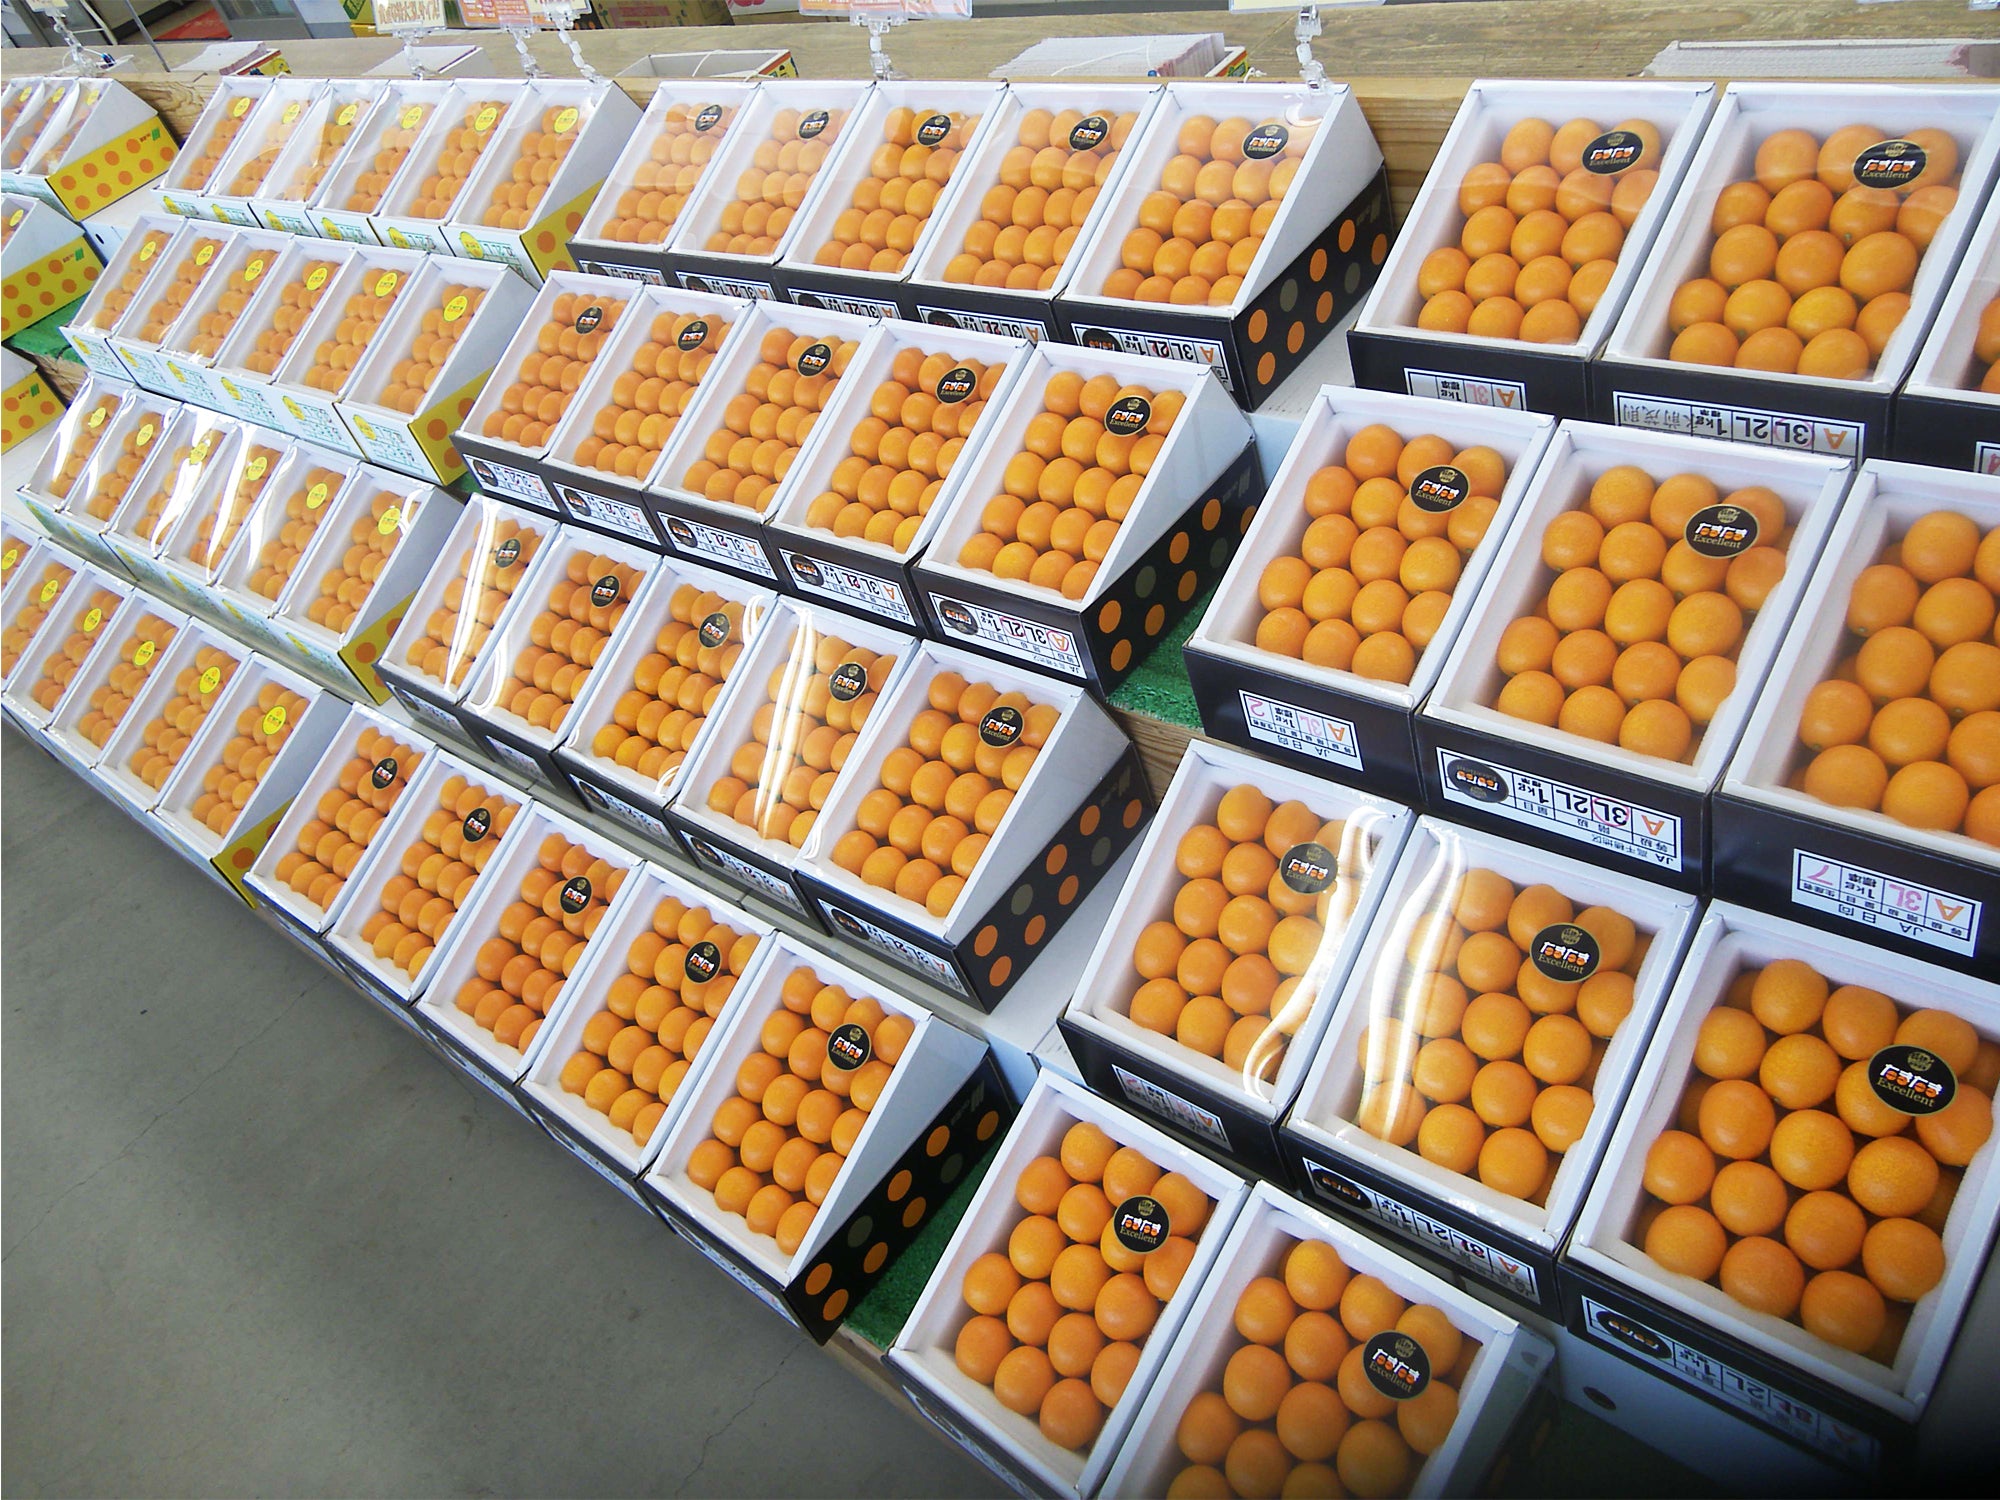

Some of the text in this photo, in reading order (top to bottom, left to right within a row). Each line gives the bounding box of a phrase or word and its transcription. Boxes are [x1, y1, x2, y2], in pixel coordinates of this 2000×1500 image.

[1589, 156, 1630, 166] Excellent
[1861, 169, 1911, 179] Excellent
[861, 305, 879, 318] 3L
[1002, 323, 1022, 338] 3L
[1026, 326, 1038, 343] A
[1147, 340, 1169, 358] 2L
[1171, 342, 1193, 360] 3L
[1200, 346, 1214, 363] A
[1466, 383, 1488, 405] 3L
[1496, 389, 1515, 407] A
[1110, 419, 1138, 429] Excellent
[1696, 416, 1728, 436] 1kg
[1735, 416, 1769, 439] 2L
[1775, 421, 1809, 445] 3L
[1823, 428, 1848, 450] A
[1415, 490, 1452, 506] Excellent
[726, 537, 744, 552] 3L
[746, 542, 757, 556] A
[1693, 534, 1741, 548] Excellent
[860, 578, 880, 595] 3L
[883, 585, 895, 601] A
[1001, 620, 1024, 637] 2L
[1024, 626, 1047, 644] 3L
[1051, 634, 1066, 649] A
[1248, 698, 1264, 717] 2
[1299, 714, 1322, 736] 3L
[1327, 723, 1345, 742] A
[1277, 735, 1330, 757] JA 日向
[1517, 782, 1665, 836] A 3L 2L 1kg
[1655, 853, 1673, 865] JA
[1807, 864, 1964, 922] A 3L 1kg 7
[1838, 904, 1923, 936] JA 日向
[1538, 954, 1584, 974] Excellent
[1877, 1077, 1935, 1107] Excellent
[1119, 1227, 1157, 1244] Excellent
[1416, 1216, 1449, 1240] 2L
[1497, 1256, 1519, 1275] A
[1369, 1361, 1412, 1393] Excellent
[1725, 1371, 1765, 1401] 2L
